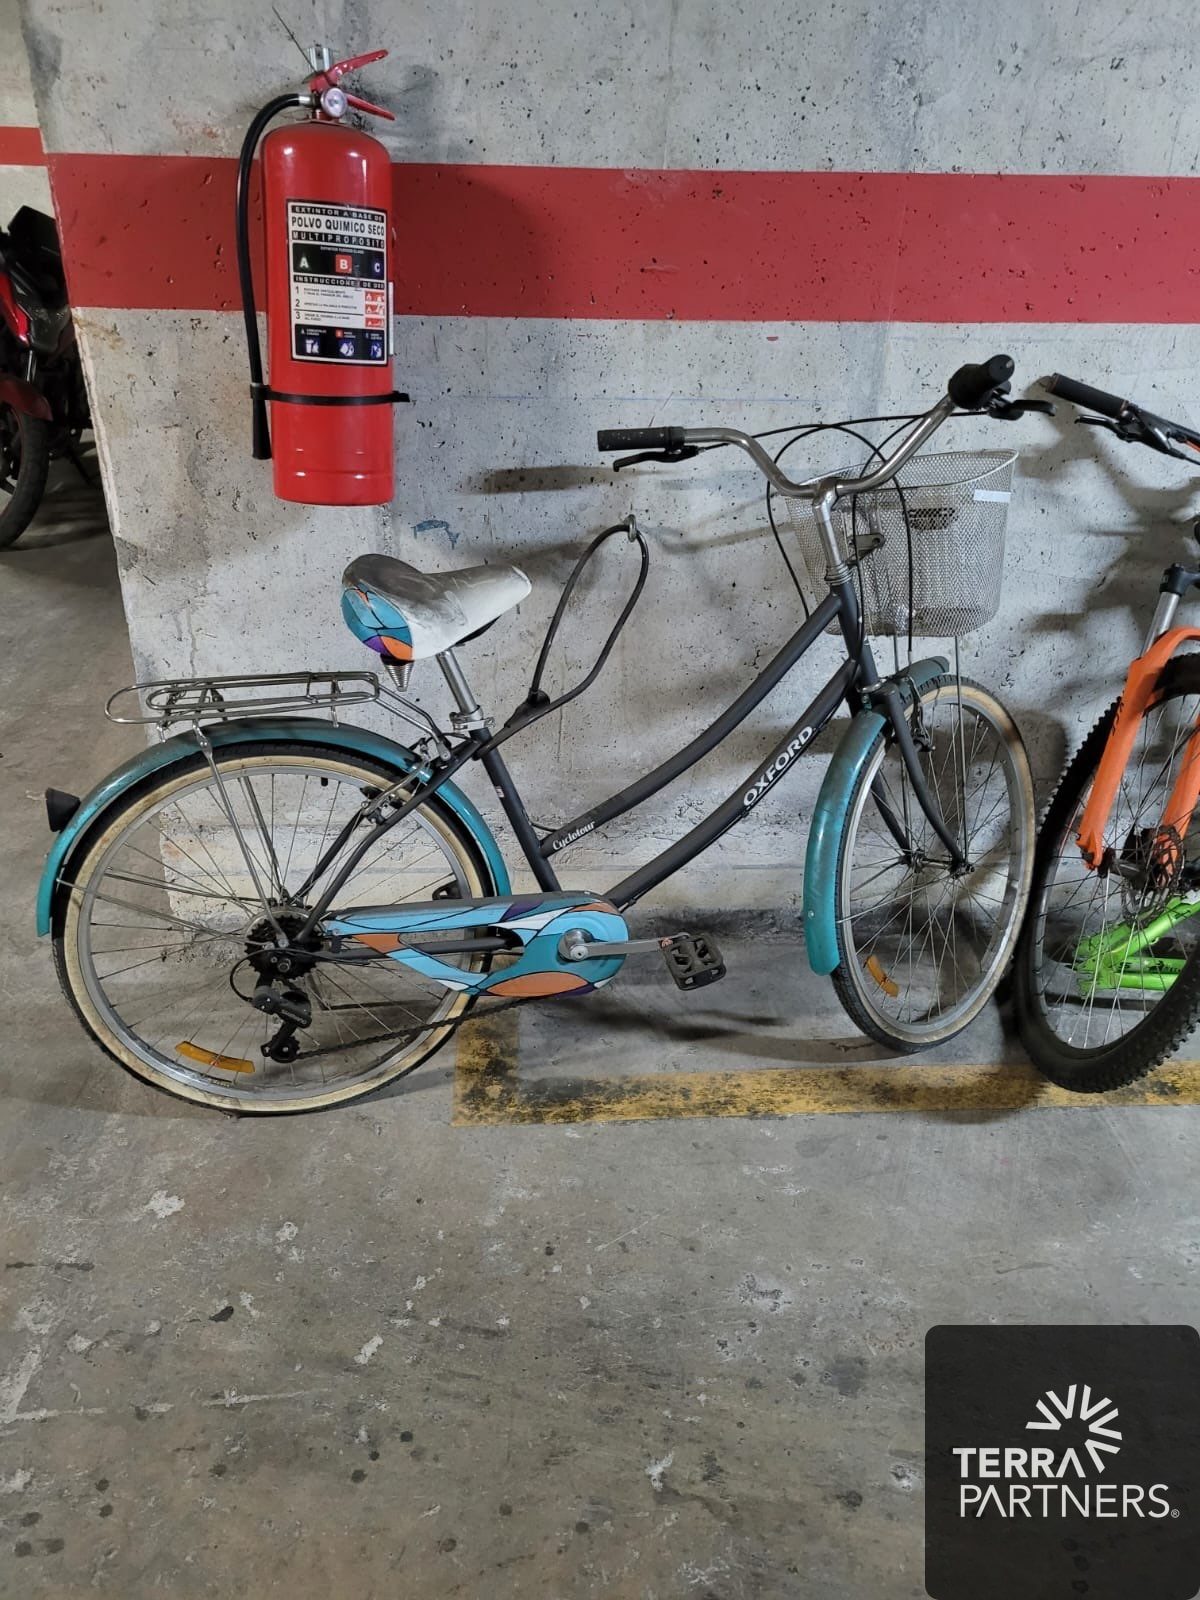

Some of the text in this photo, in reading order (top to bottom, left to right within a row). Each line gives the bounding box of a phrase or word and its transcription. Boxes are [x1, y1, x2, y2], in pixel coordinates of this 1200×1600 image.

[295, 207, 339, 216] EXTINTOR
[352, 211, 372, 220] BASE
[292, 216, 384, 236] POLVO QUIMICO SECO
[292, 231, 385, 248] MULTIPROPOSITO
[300, 256, 381, 273] A B C
[295, 298, 300, 307] 2
[295, 311, 300, 320] 3
[743, 726, 813, 806] OXFORD
[552, 821, 595, 850] Cyclotour
